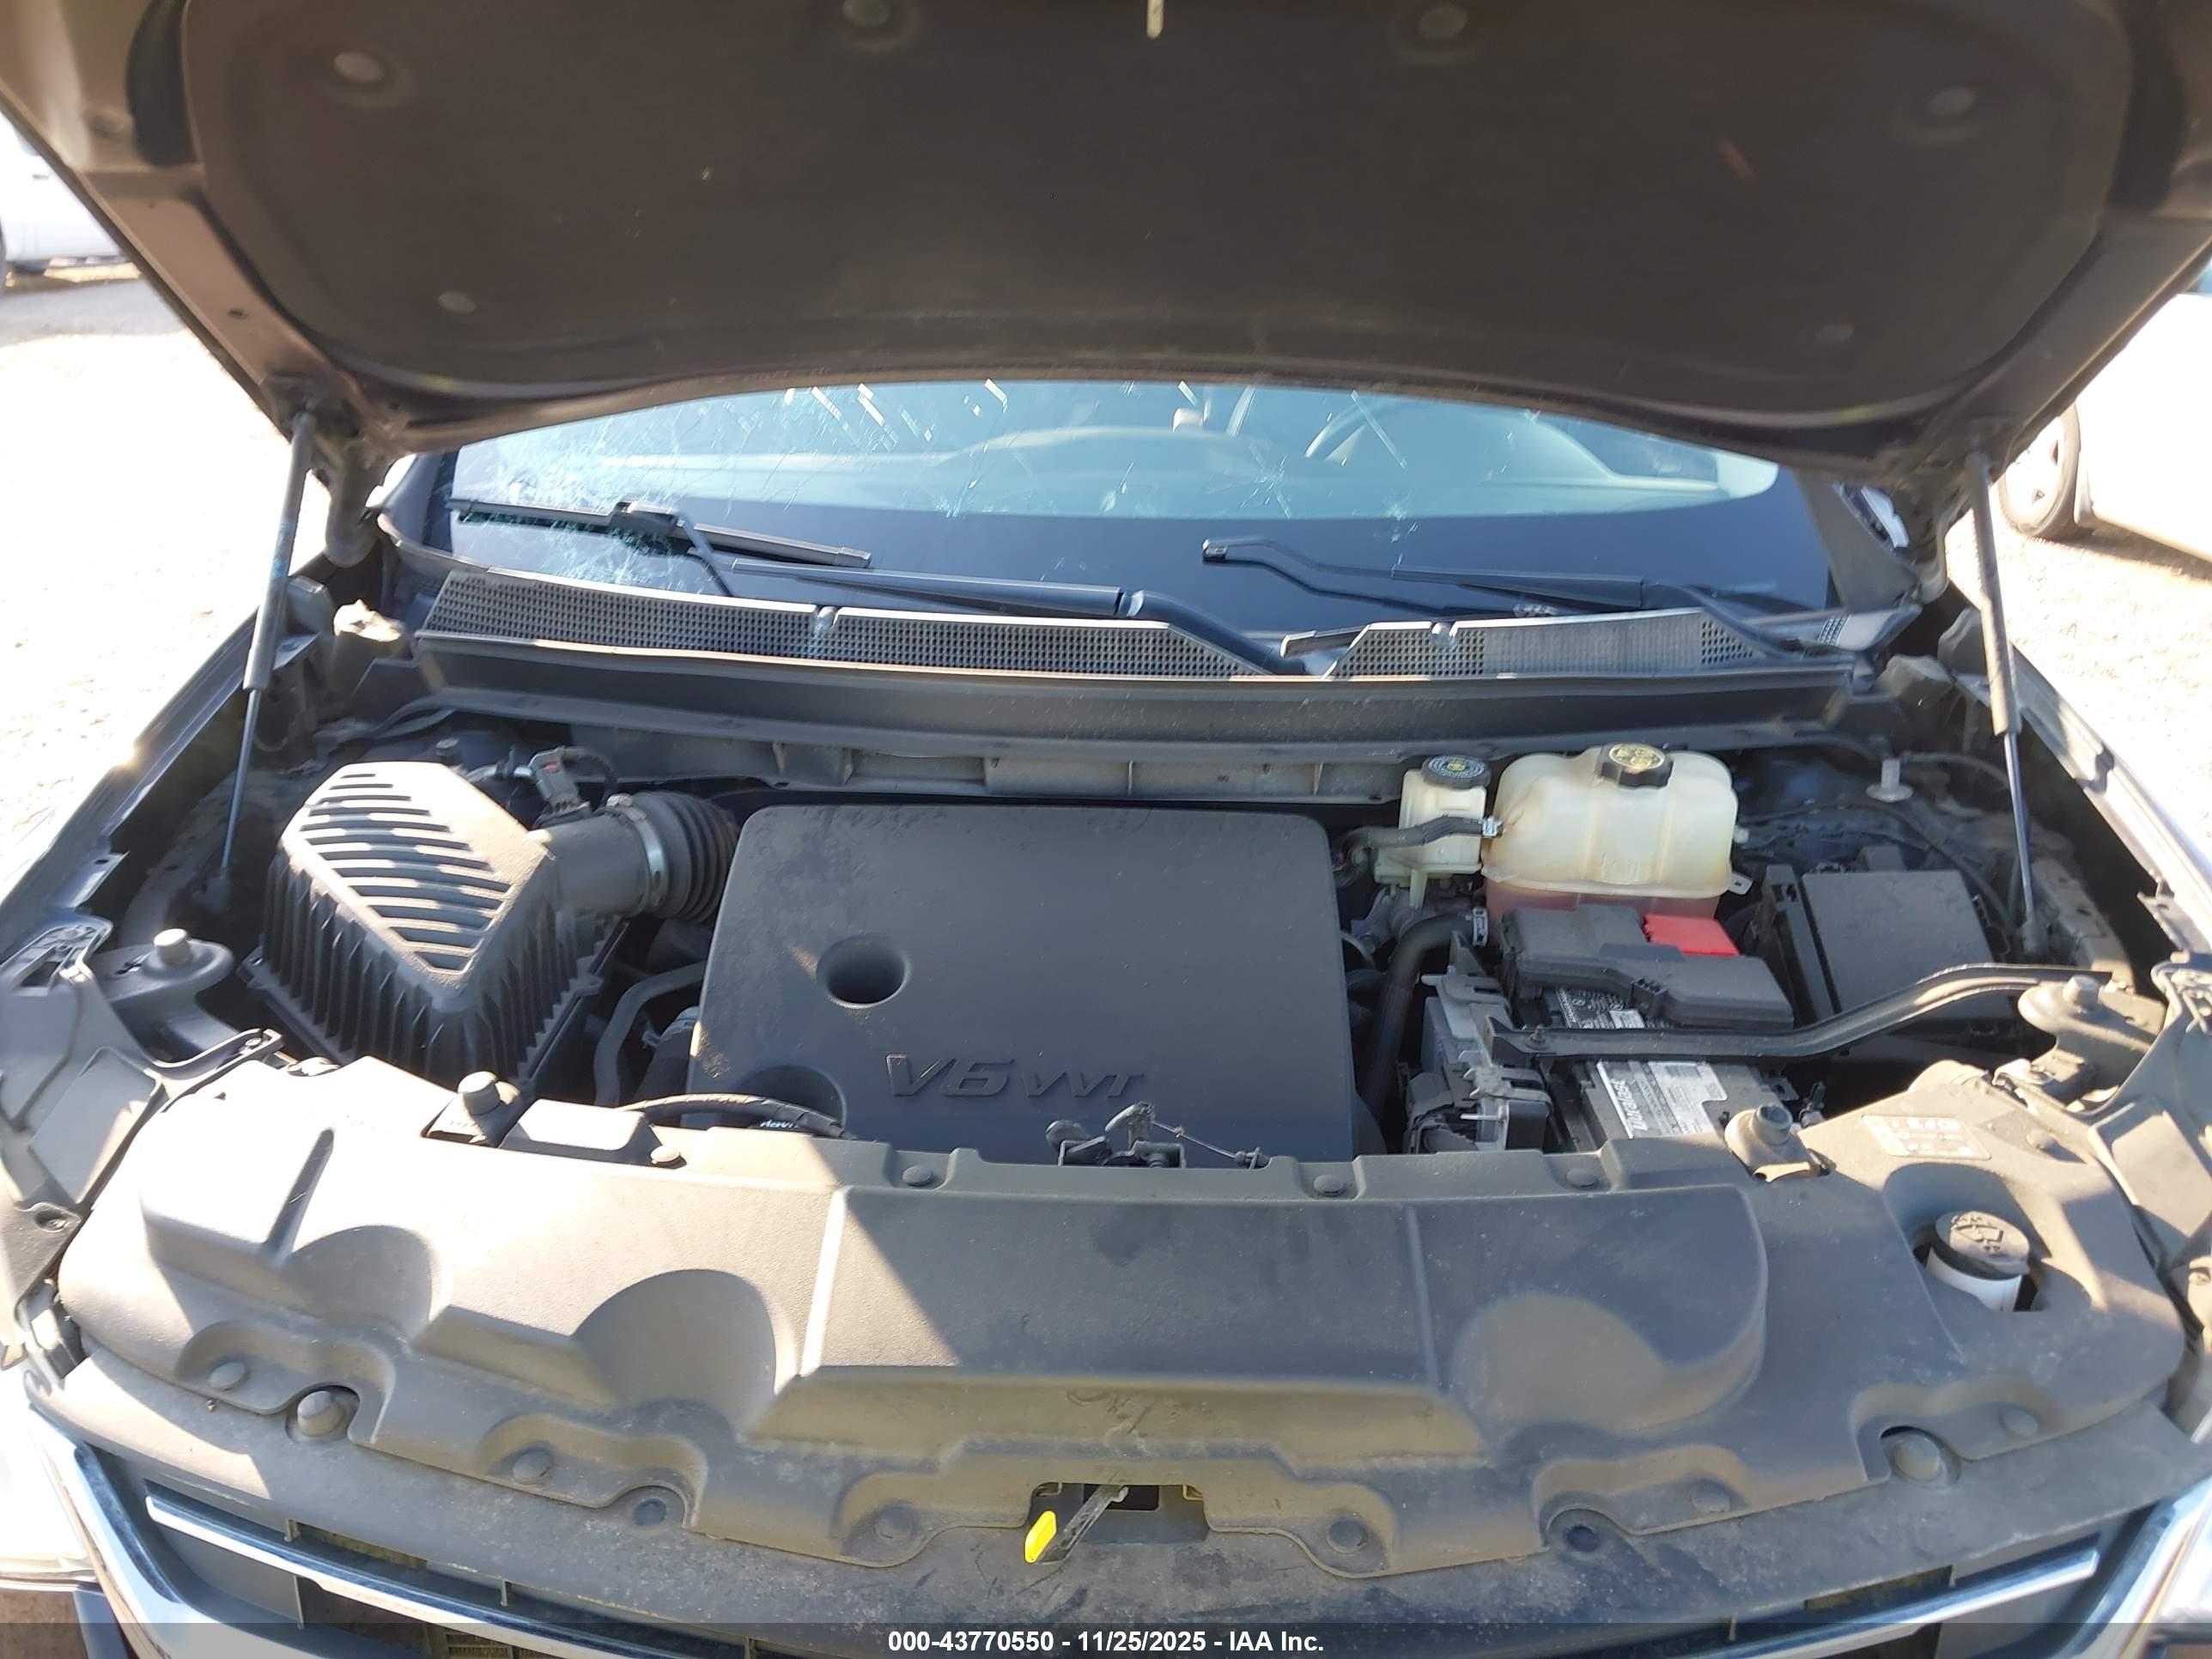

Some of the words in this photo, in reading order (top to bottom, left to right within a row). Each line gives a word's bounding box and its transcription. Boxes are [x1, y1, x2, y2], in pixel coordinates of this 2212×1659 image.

[885, 1051, 1014, 1097] V6
[1021, 1070, 1146, 1099] VVT
[1609, 1079, 1648, 1131] Duralast
